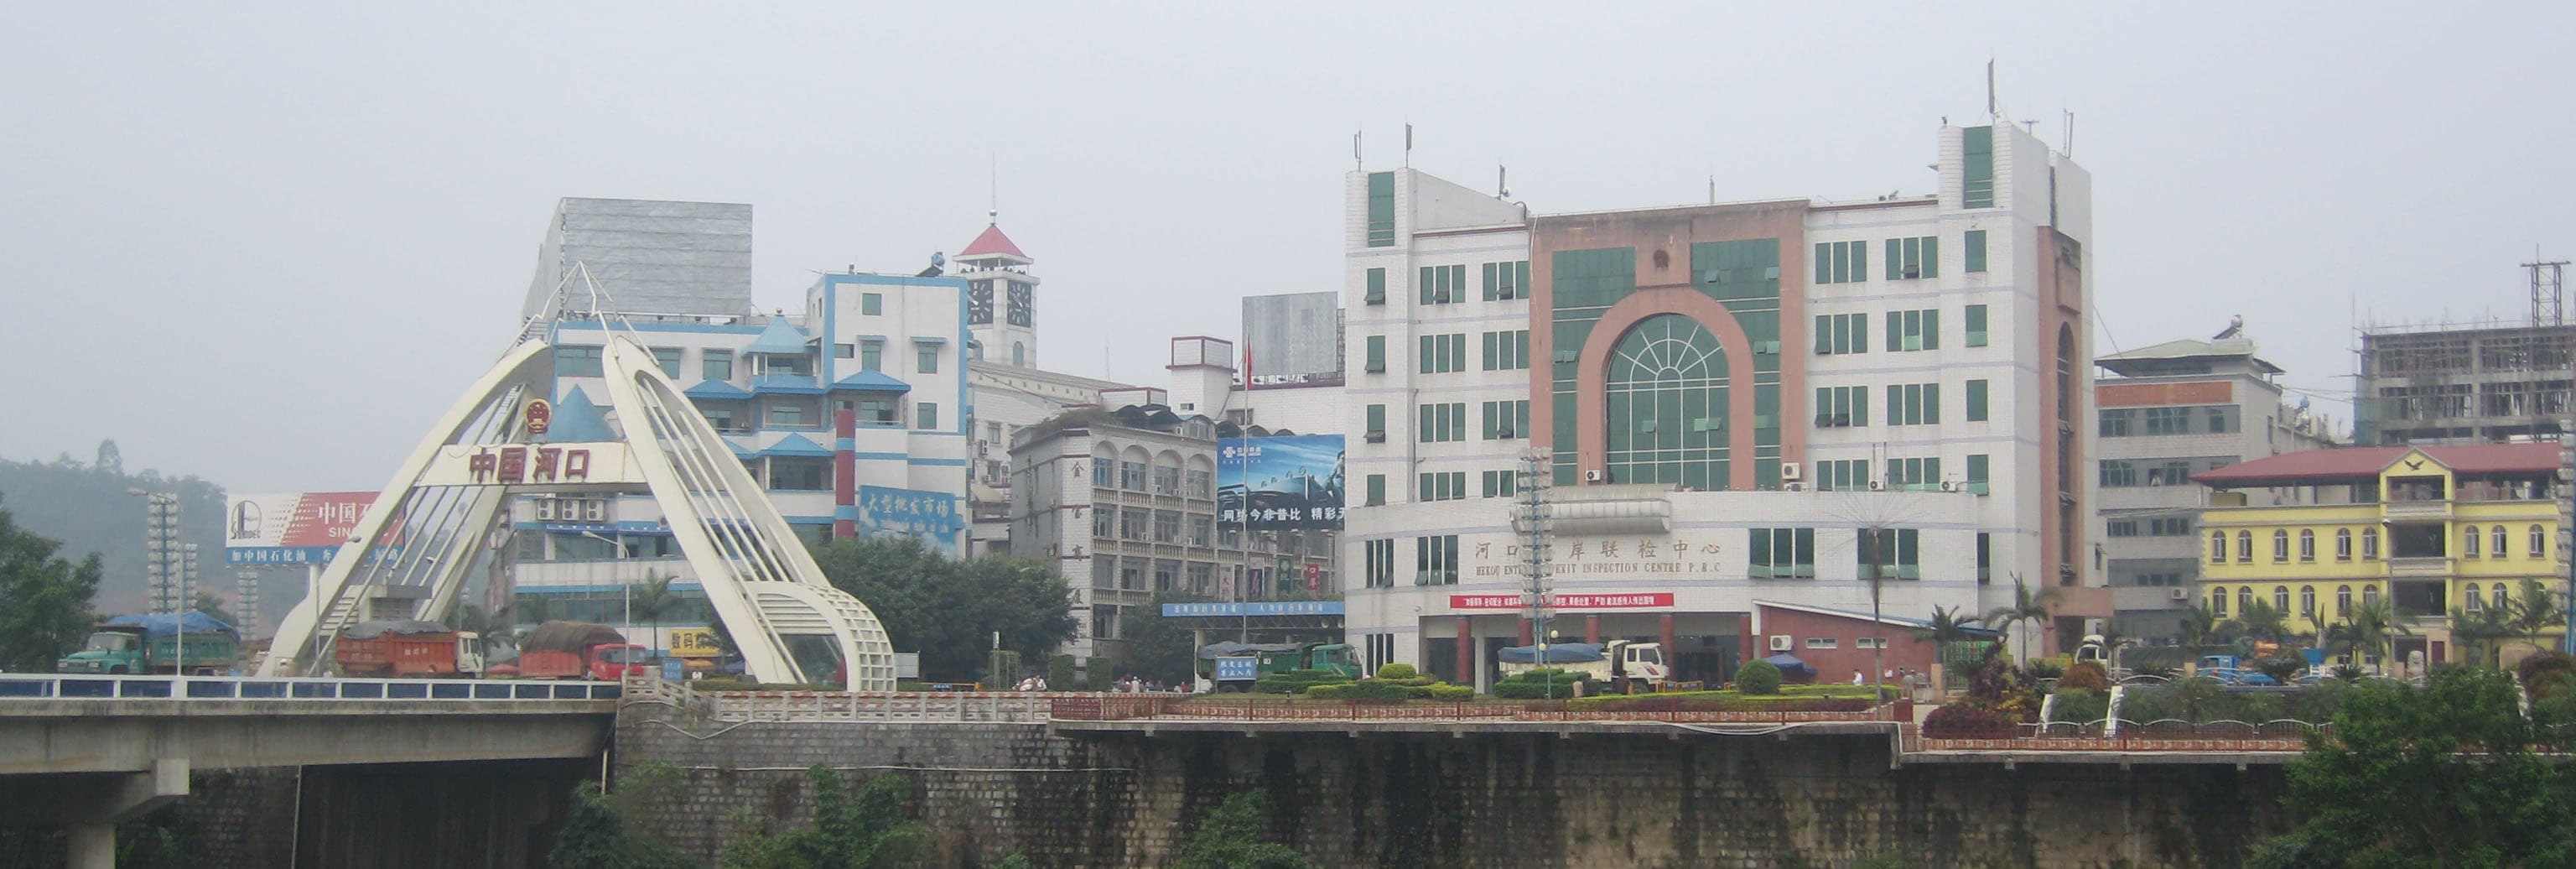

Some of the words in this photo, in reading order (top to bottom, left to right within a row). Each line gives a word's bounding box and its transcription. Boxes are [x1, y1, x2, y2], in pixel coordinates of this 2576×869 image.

[470, 447, 589, 482] 中国河口
[1476, 539, 1721, 561] 河口岸联检中心
[1476, 565, 1500, 576] HEKOU
[1583, 563, 1638, 573] INSPECTION
[1644, 562, 1681, 572] CENTRE
